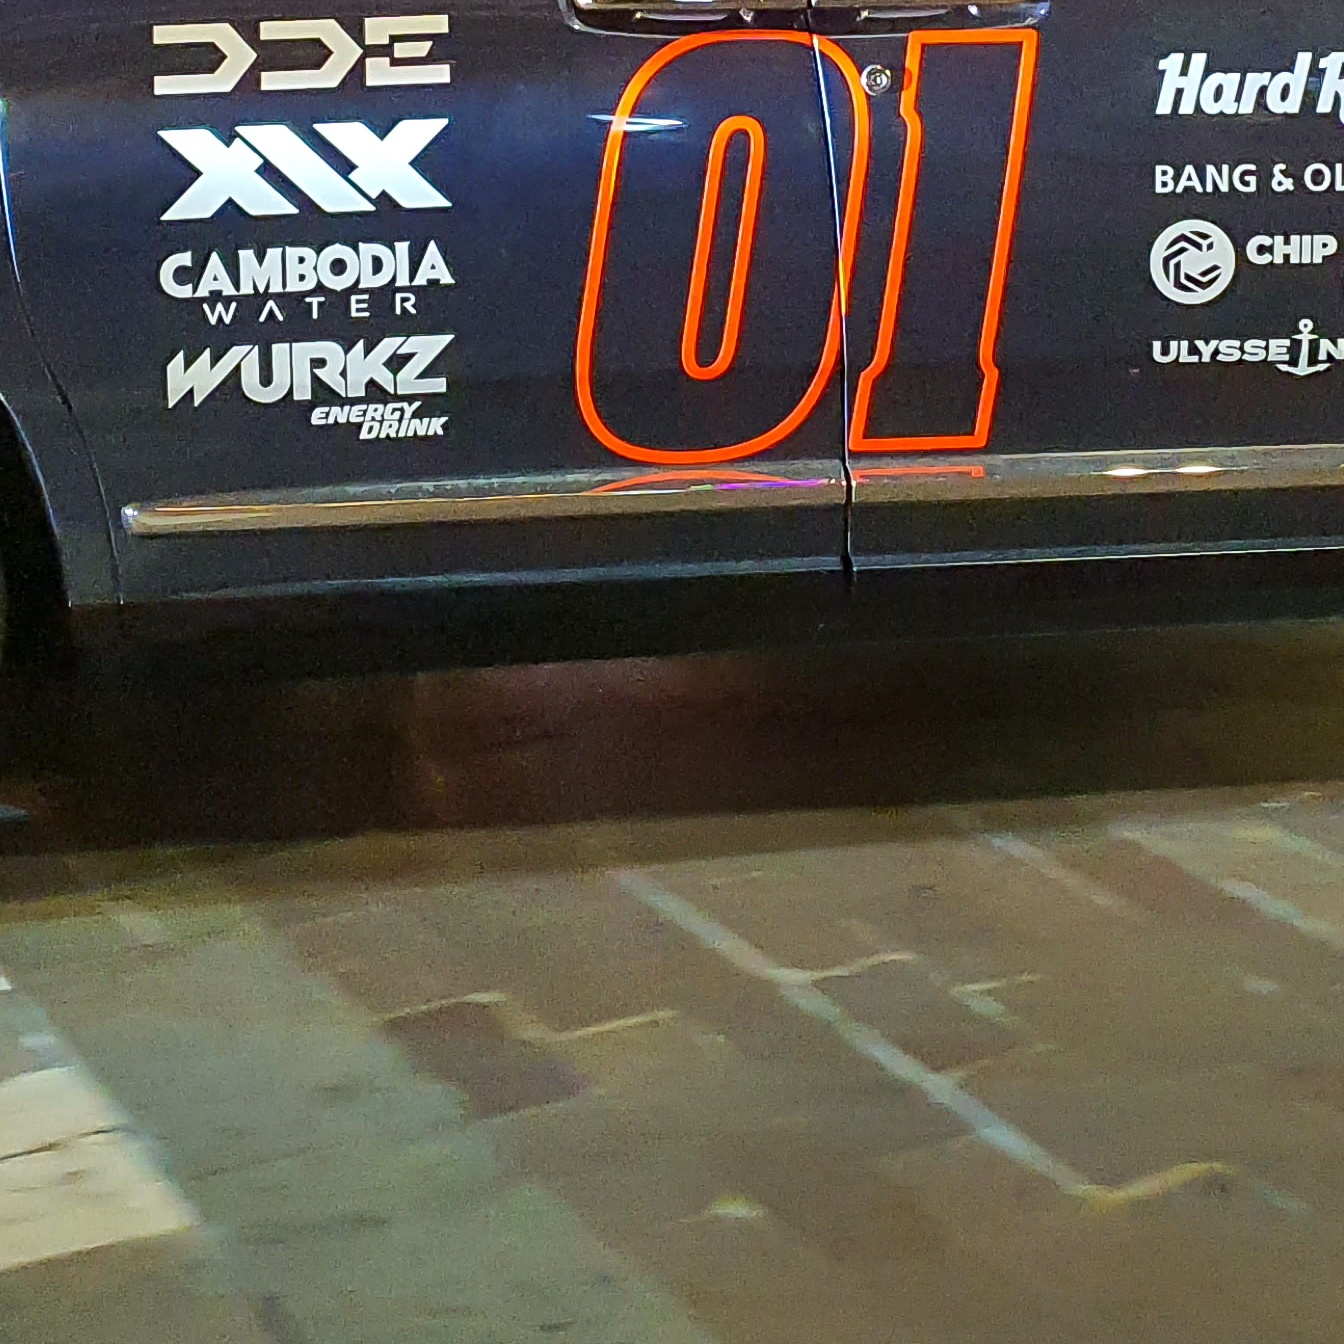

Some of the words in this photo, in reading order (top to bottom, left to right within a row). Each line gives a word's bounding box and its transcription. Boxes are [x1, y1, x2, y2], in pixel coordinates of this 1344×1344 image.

[153, 14, 451, 95] DDE
[1155, 52, 1313, 115] Hard
[1155, 164, 1257, 194] BANG
[1271, 163, 1295, 192] &
[574, 27, 1040, 463] 01
[1246, 234, 1338, 264] CHIP
[159, 239, 456, 298] CAMBODIA
[202, 292, 417, 326] WATER
[1152, 339, 1291, 363] ULYSSE
[166, 334, 455, 409] WURKZ
[310, 401, 422, 425] ENERGY
[359, 416, 449, 440] DRINK
